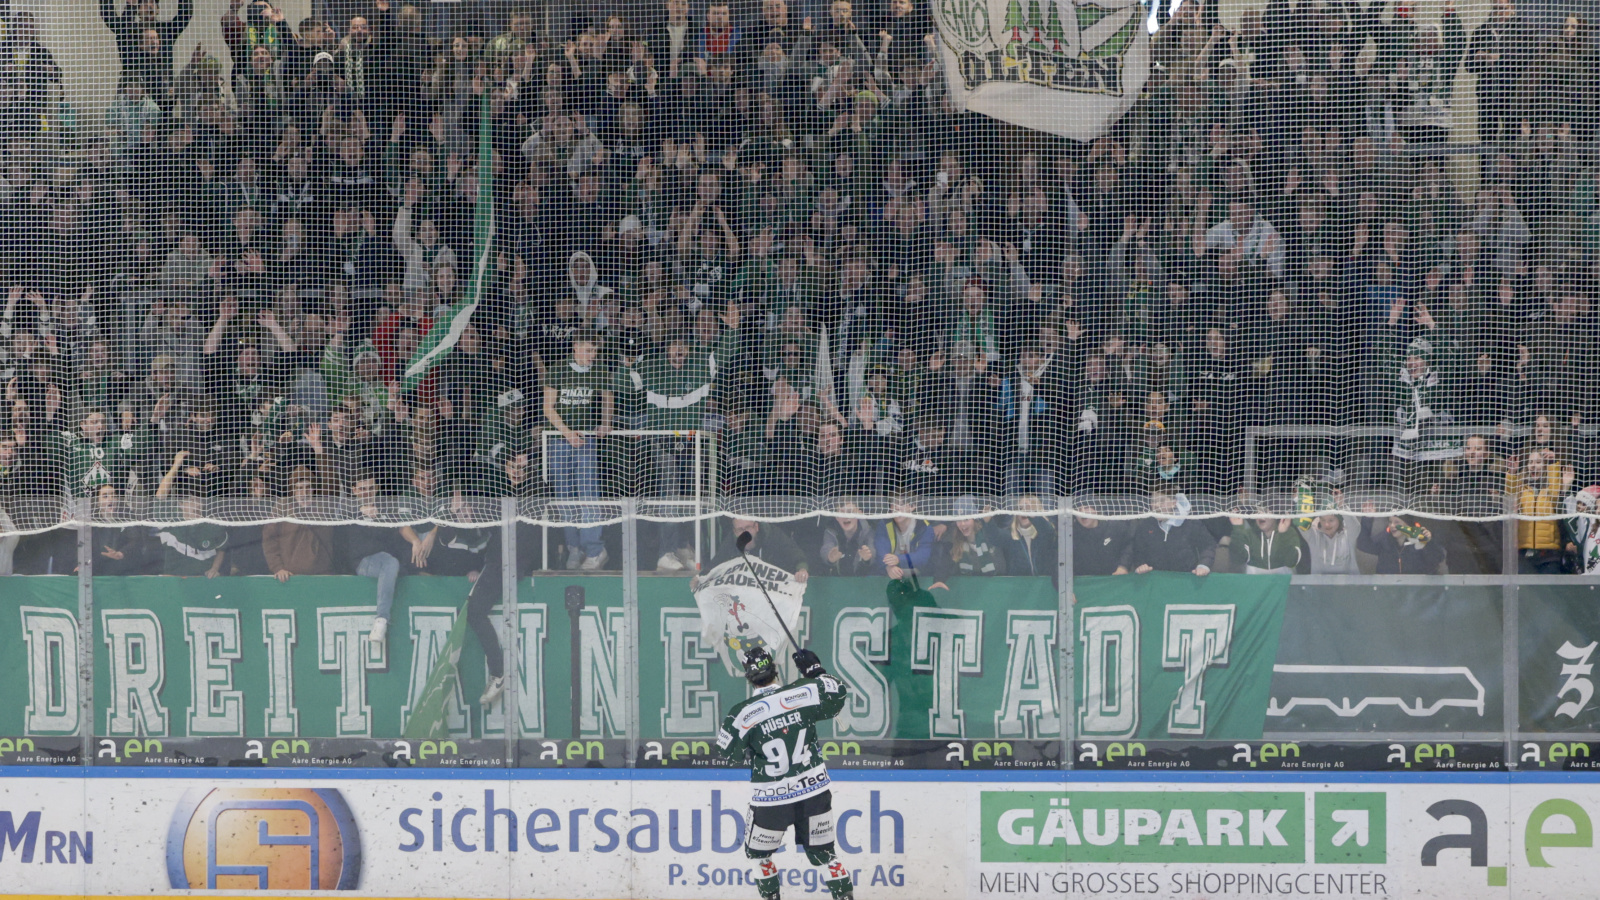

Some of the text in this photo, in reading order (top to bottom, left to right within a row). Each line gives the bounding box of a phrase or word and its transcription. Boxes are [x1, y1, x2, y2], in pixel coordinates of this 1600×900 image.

[760, 711, 803, 735] HÜSLER
[36, 756, 64, 764] Energie
[98, 738, 162, 762] a.en
[164, 756, 192, 764] Energie
[245, 739, 309, 763] a.en
[311, 758, 340, 766] Energie
[393, 740, 457, 764] a.en
[460, 758, 488, 766] Energie
[540, 741, 604, 764] a.en
[645, 741, 710, 765] a.en
[762, 728, 812, 777] 94
[946, 741, 1013, 766] a.en
[1079, 743, 1146, 766] a.en
[1233, 743, 1300, 767] a.en
[1387, 743, 1455, 767] a.en
[1522, 743, 1589, 767] a.en
[863, 760, 890, 768] Energie
[1014, 760, 1043, 768] Energie
[1148, 760, 1177, 768] Energie
[1302, 761, 1331, 769] Energie
[1457, 762, 1486, 770] Energie
[398, 790, 905, 854] sichersaubch
[997, 798, 1289, 847] GÄUPARK
[668, 864, 688, 886] P.
[871, 865, 905, 887] AG
[980, 872, 1387, 896] MEIN GROSSES SHOPPINGCENTER
